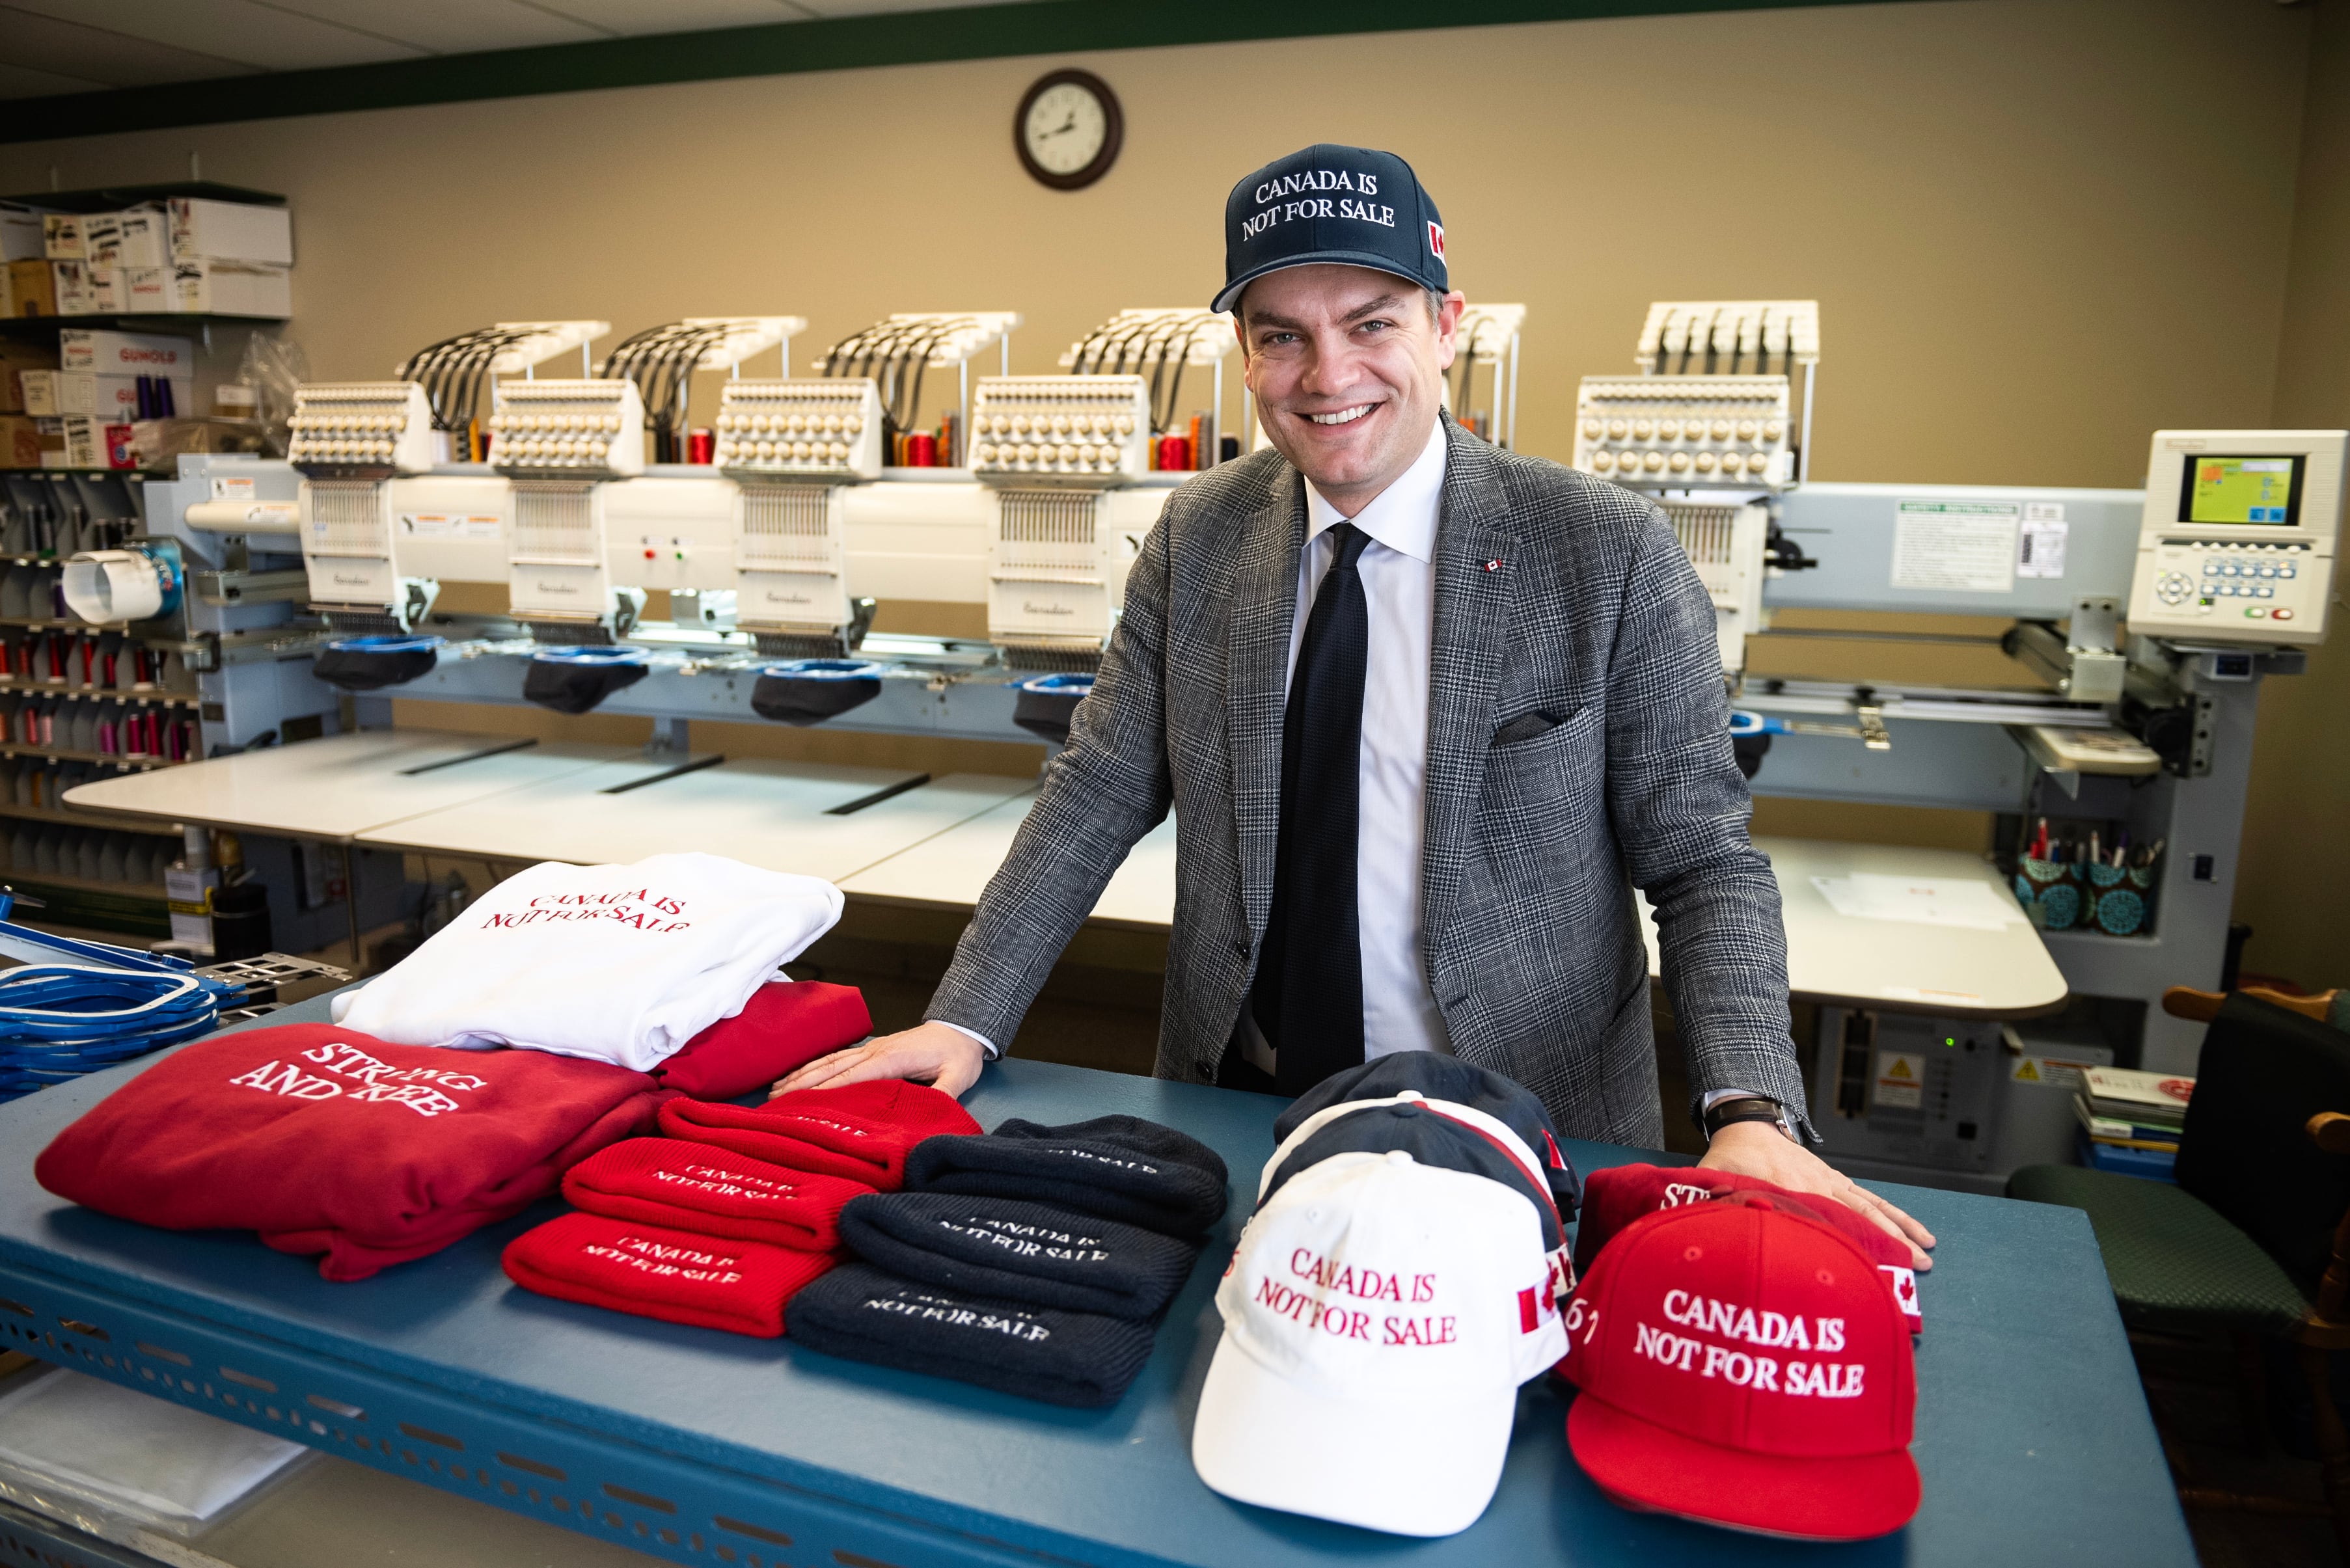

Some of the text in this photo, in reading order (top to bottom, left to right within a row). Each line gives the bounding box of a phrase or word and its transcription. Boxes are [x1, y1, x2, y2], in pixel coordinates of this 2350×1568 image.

[1255, 170, 1378, 204] CANADA IS
[1242, 198, 1395, 241] NOT FOR SALE
[480, 910, 549, 928] NOT
[651, 897, 686, 915] IS
[229, 1061, 459, 1116] AND REE
[301, 1043, 487, 1090] STRNG
[1291, 1248, 1436, 1303] CANADA IS
[976, 1315, 1050, 1341] SALE
[1255, 1275, 1456, 1345] NOT FOR SALE
[1663, 1289, 1846, 1353] CANADA IS
[1633, 1322, 1865, 1398] NOT FOR SALE
